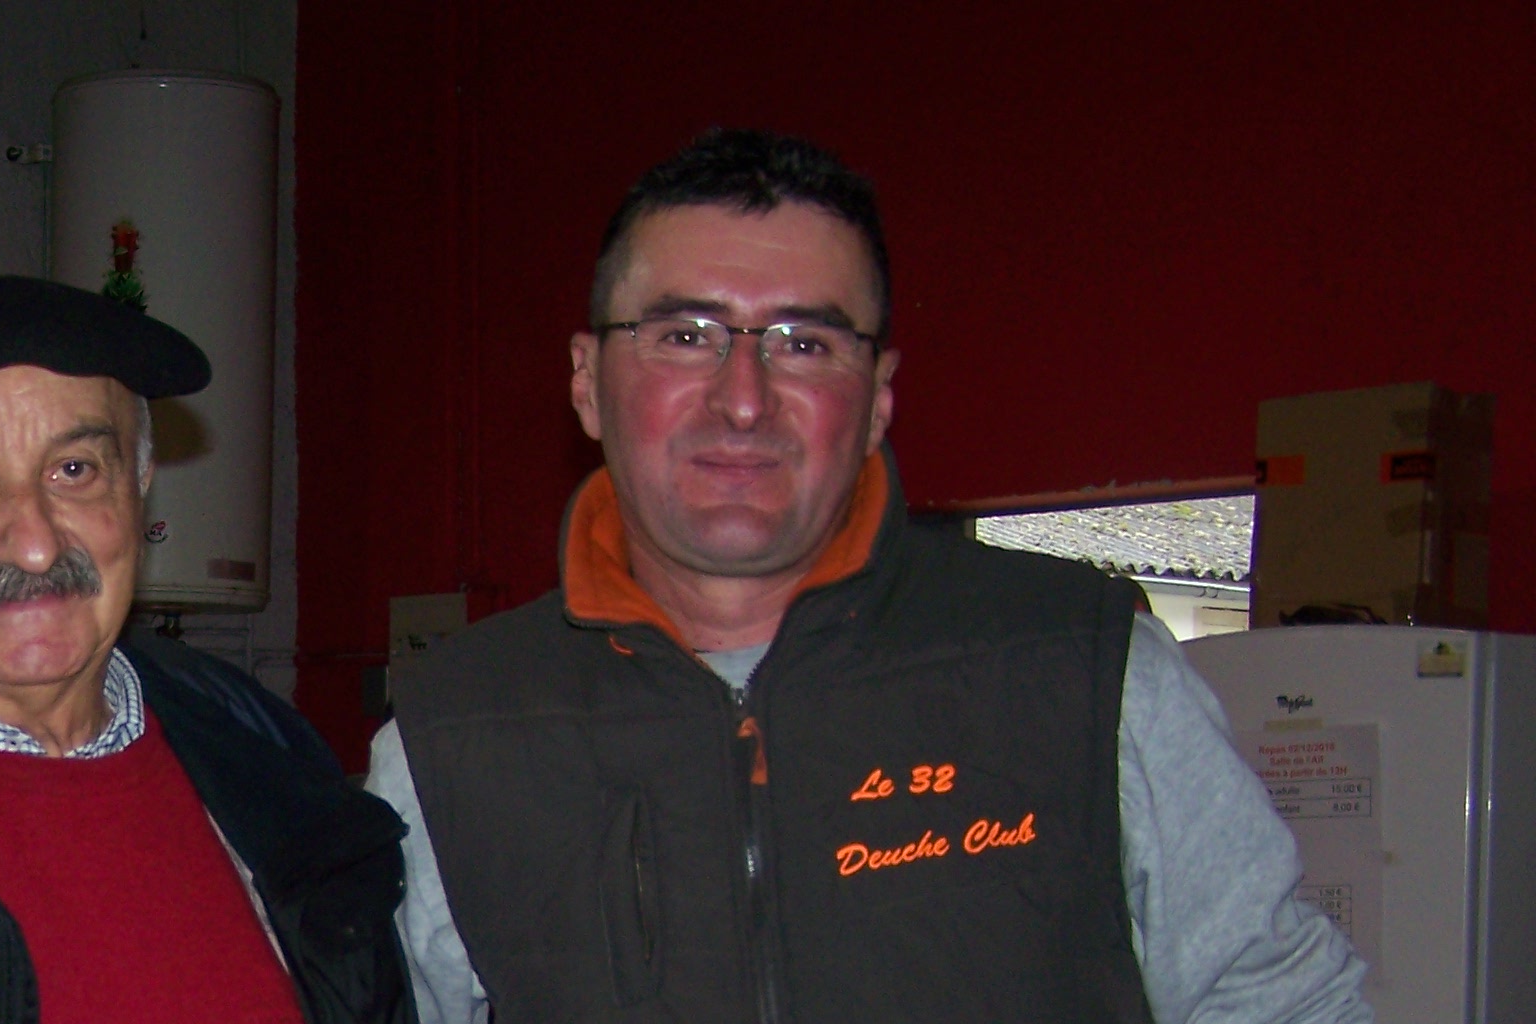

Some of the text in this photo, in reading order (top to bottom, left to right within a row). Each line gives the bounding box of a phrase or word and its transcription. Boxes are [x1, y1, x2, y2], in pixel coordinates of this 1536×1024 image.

[850, 763, 956, 802] Le 32
[1316, 767, 1327, 776] de
[835, 813, 1036, 877] Deuche Club
